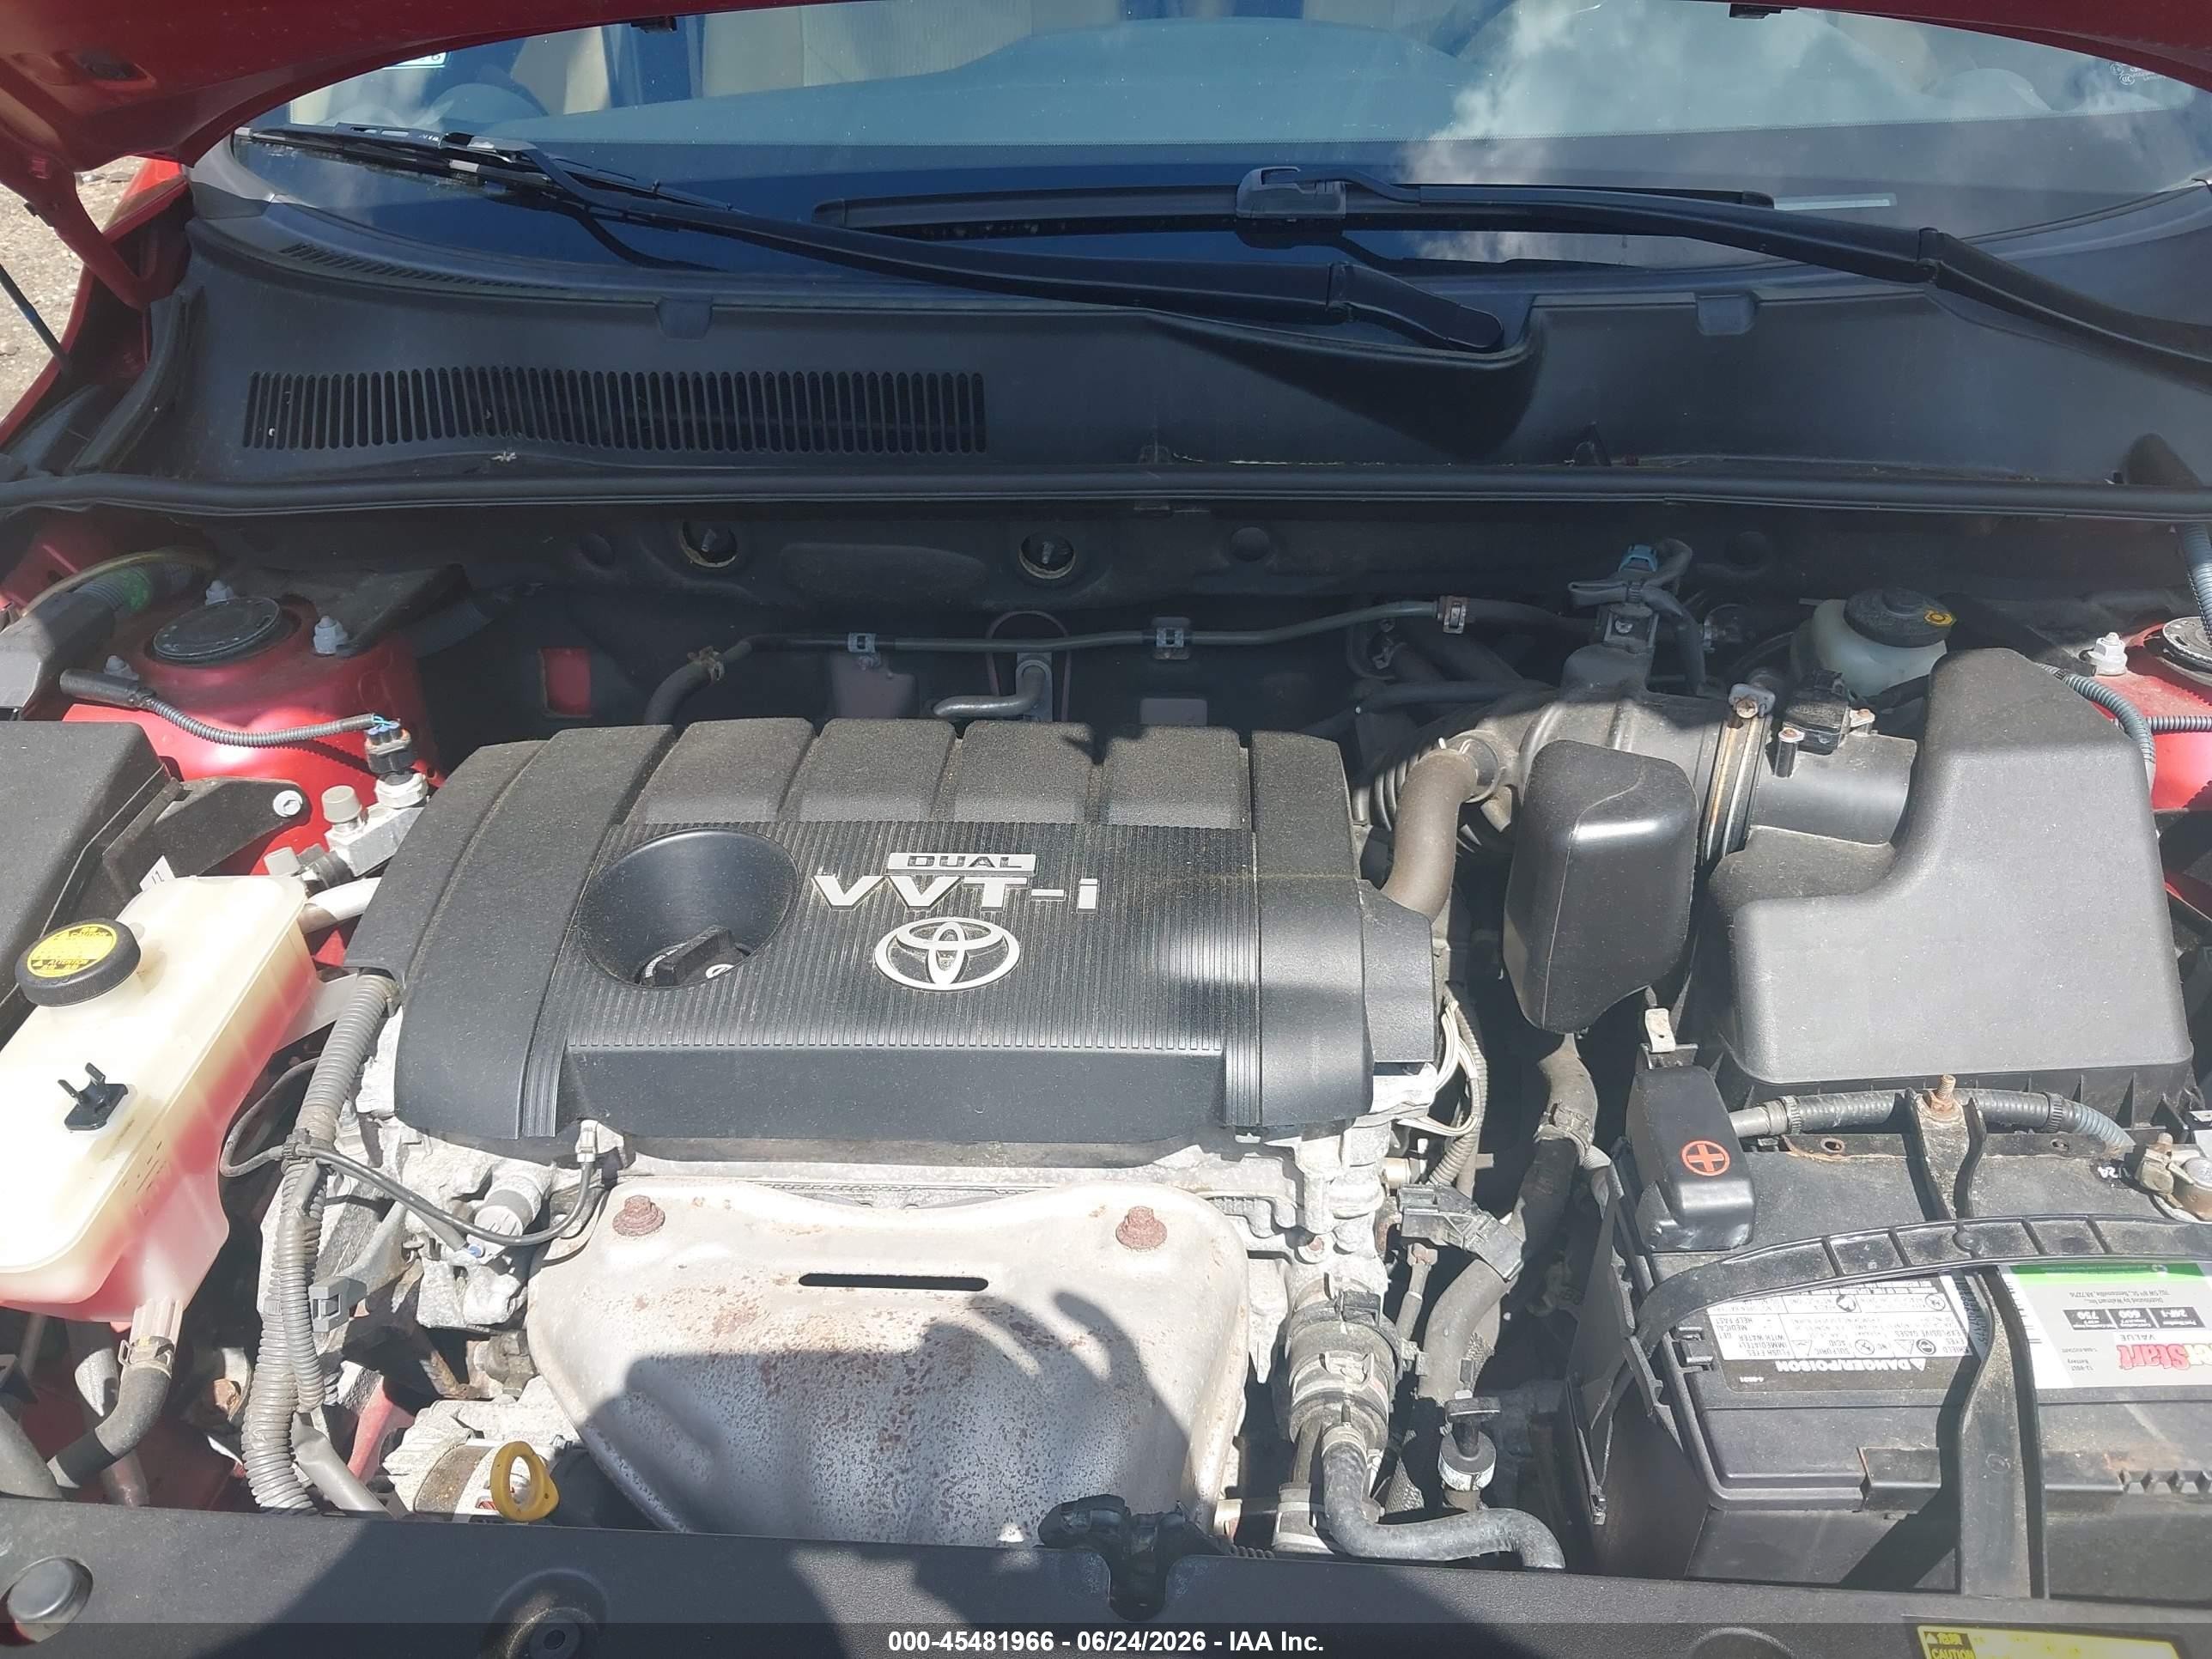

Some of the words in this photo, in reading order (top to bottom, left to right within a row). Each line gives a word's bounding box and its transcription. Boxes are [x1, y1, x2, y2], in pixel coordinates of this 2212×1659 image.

[907, 854, 1024, 868] DUAL
[811, 874, 1099, 914] VVT-i
[2076, 1310, 2100, 1320] 750
[2118, 1310, 2141, 1319] 600
[1921, 1329, 1960, 1338] EXPLOSIVE
[1814, 1346, 1850, 1355] SULFURIC
[1942, 1346, 1968, 1354] SHIELD
[1774, 1358, 1911, 1372] DANGER/POISON
[1931, 1648, 1976, 1659] CAUTION
